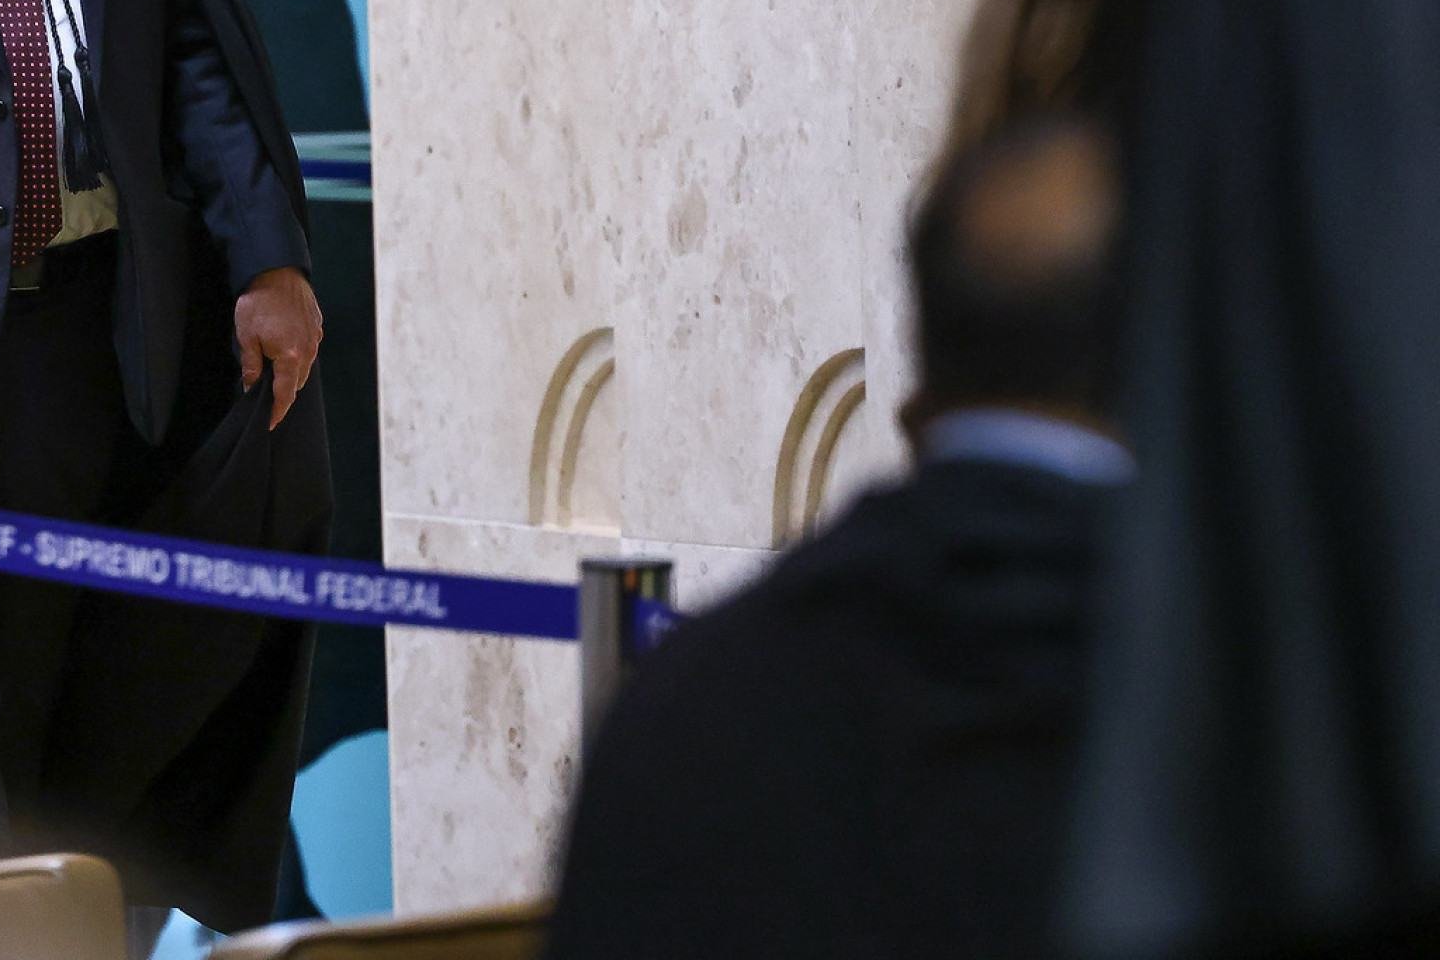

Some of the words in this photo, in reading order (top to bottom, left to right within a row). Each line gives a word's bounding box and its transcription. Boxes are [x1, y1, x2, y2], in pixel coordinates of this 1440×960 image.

[34, 531, 170, 584] SUPREMO
[173, 552, 309, 605] TRIBUNAL
[315, 570, 447, 618] FEDERAL
